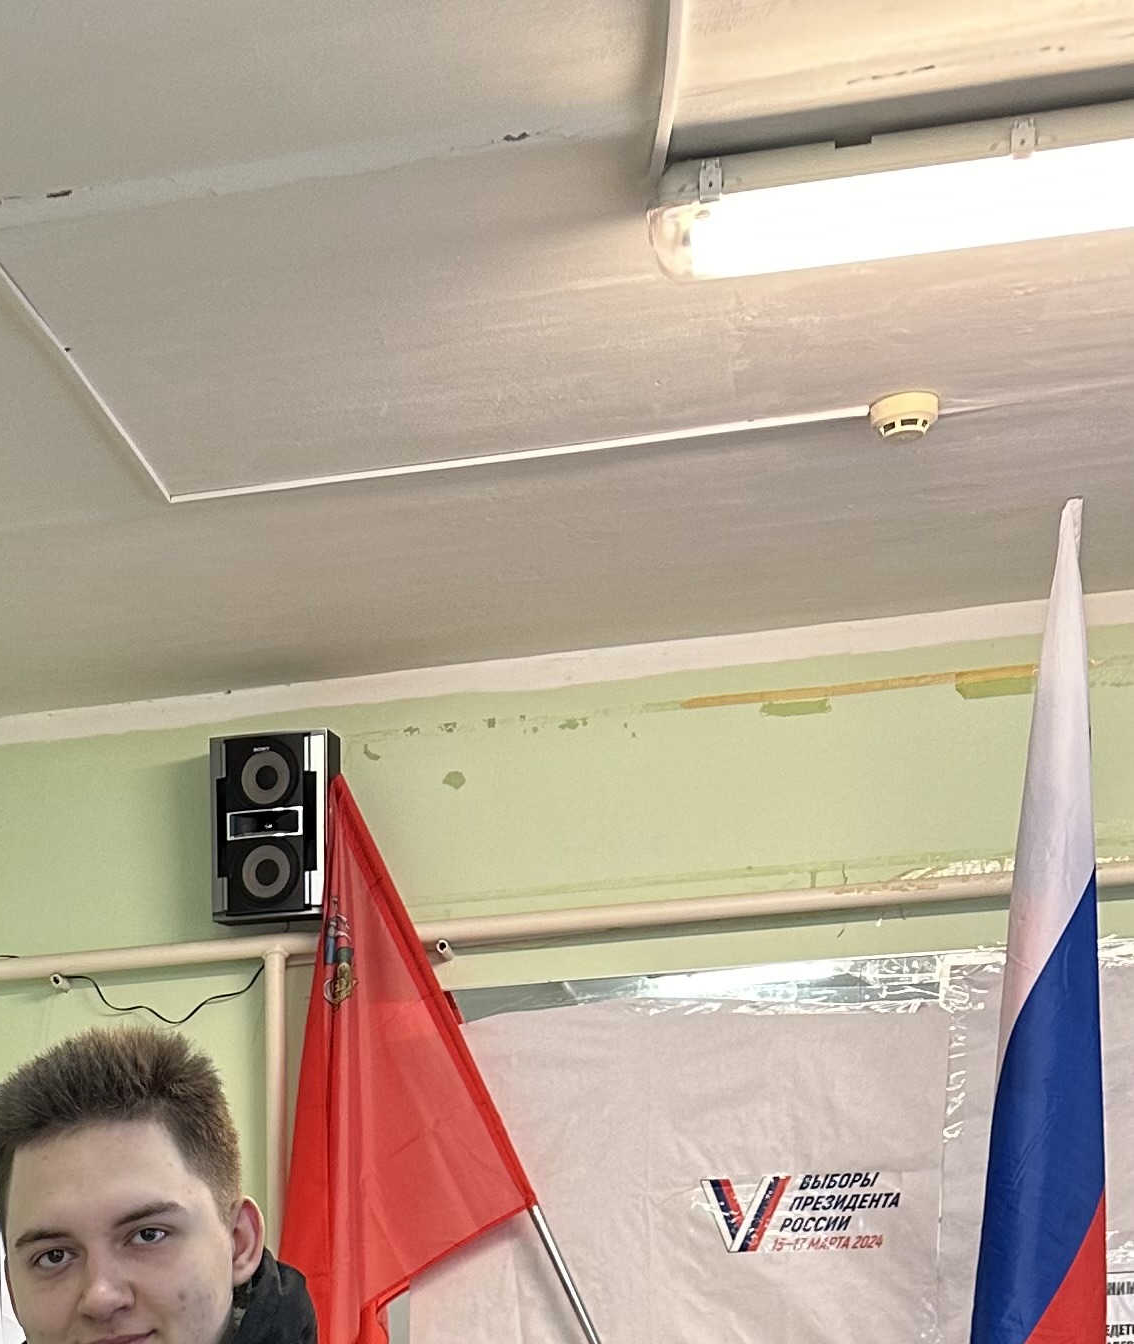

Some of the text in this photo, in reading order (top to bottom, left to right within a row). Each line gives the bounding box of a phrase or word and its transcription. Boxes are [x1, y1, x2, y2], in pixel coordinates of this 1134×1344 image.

[799, 1172, 880, 1191] ВЫБОРЫ
[789, 1192, 901, 1212] ПРЕЗИДЕНТА
[779, 1215, 852, 1232] РОССИИ
[808, 1236, 853, 1251] МАРТА
[854, 1234, 884, 1250] 2024
